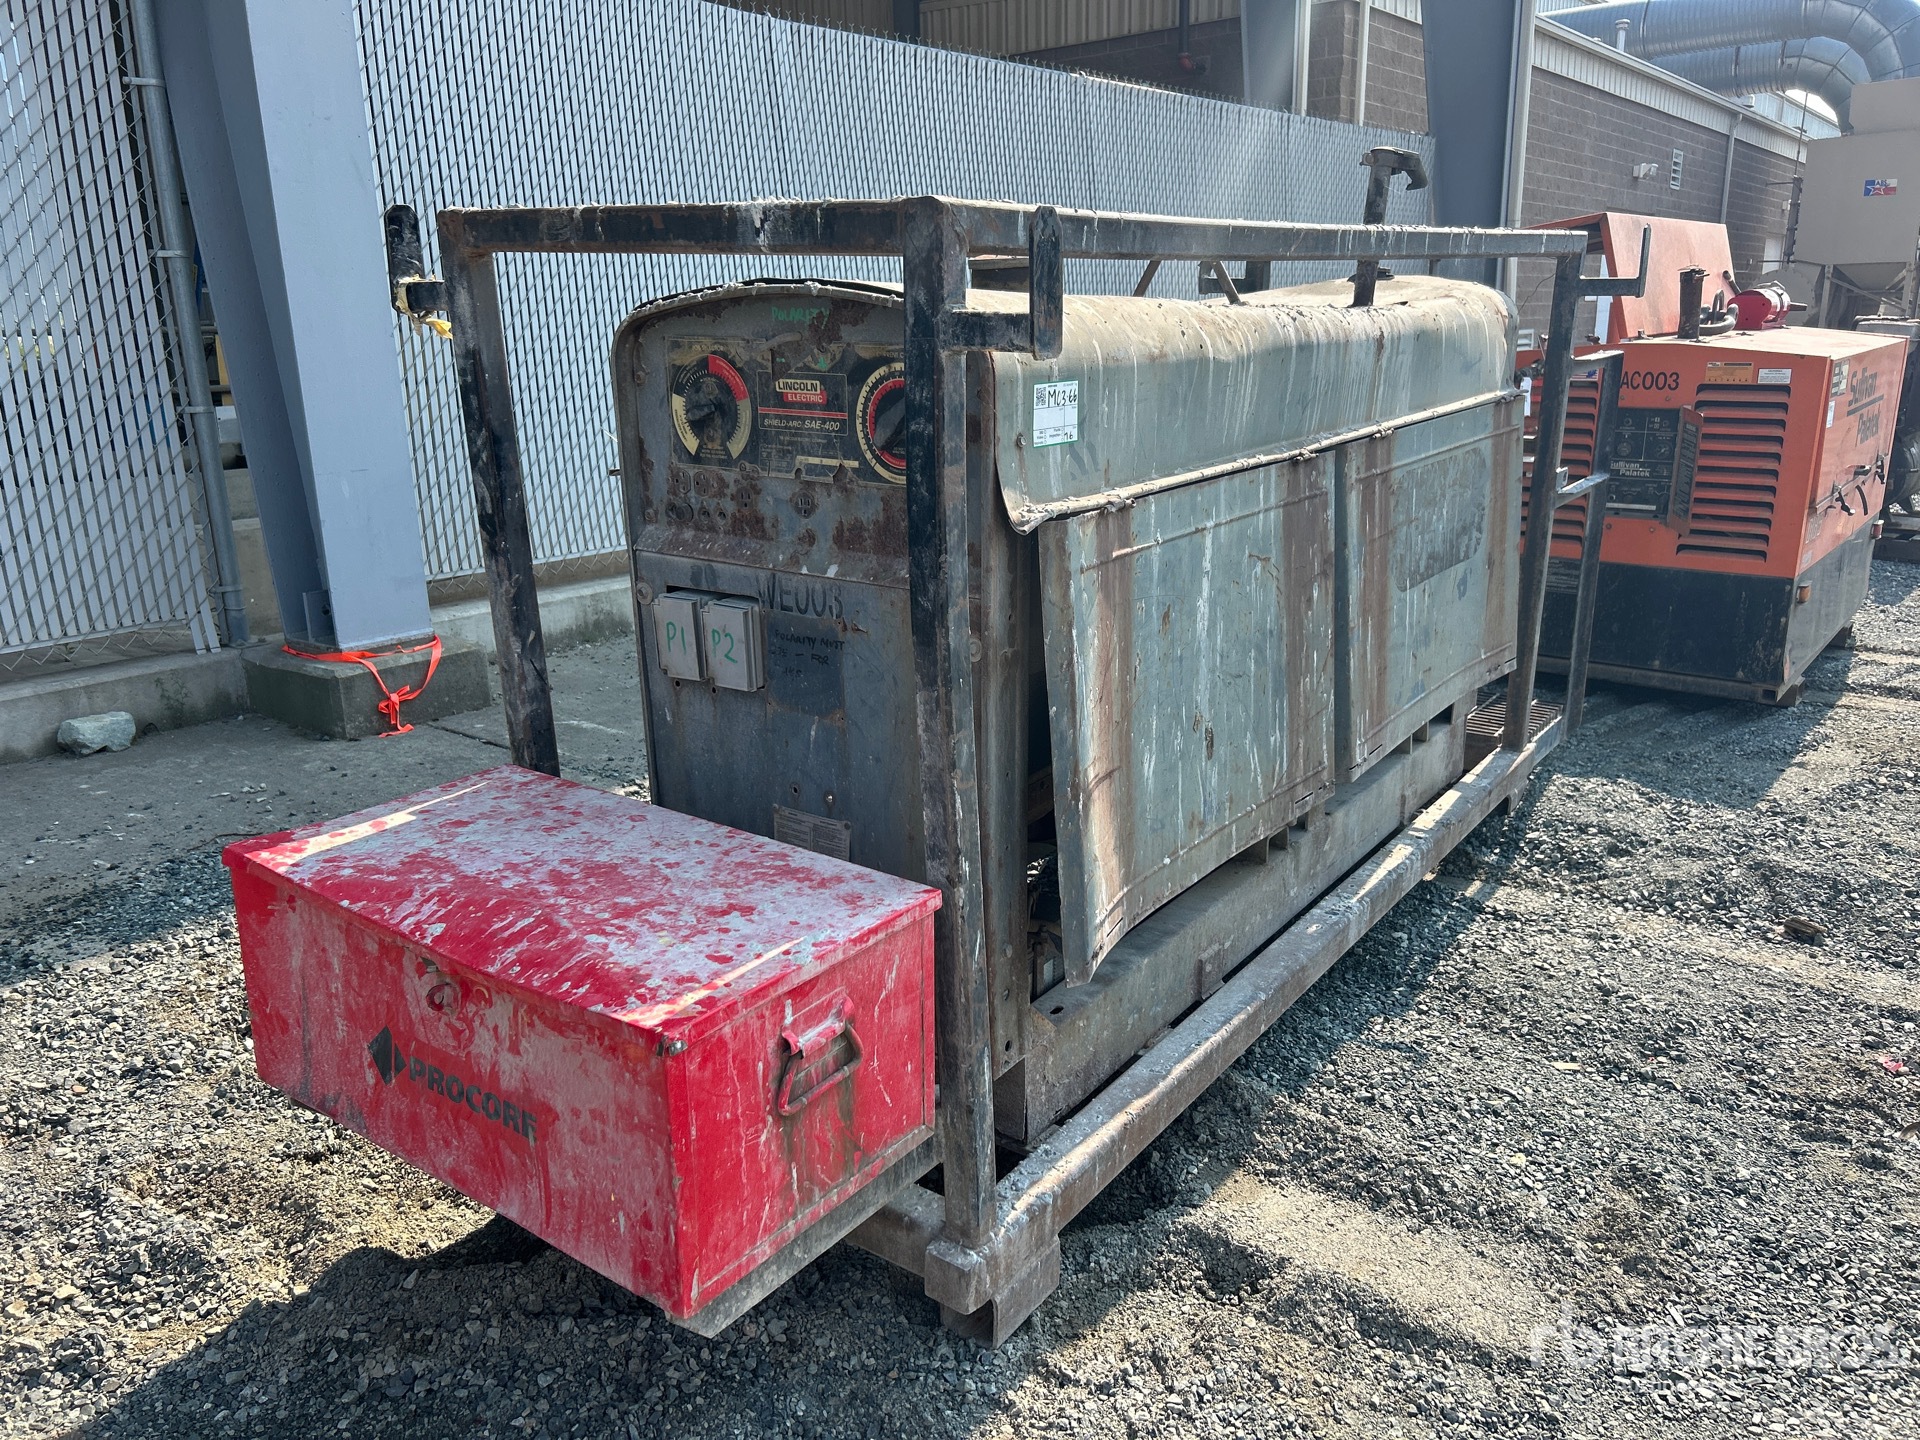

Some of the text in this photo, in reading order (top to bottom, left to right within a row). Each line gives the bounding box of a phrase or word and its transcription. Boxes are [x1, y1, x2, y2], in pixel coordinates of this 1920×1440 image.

[778, 381, 818, 392] LINCOLN
[1620, 371, 1680, 391] AC003
[787, 393, 823, 403] ELECTRIC
[804, 420, 840, 431] SAE-400
[1619, 469, 1650, 477] Palatek
[666, 621, 688, 655] P1
[711, 628, 738, 663] P2
[775, 629, 845, 650] POLARITY MUST
